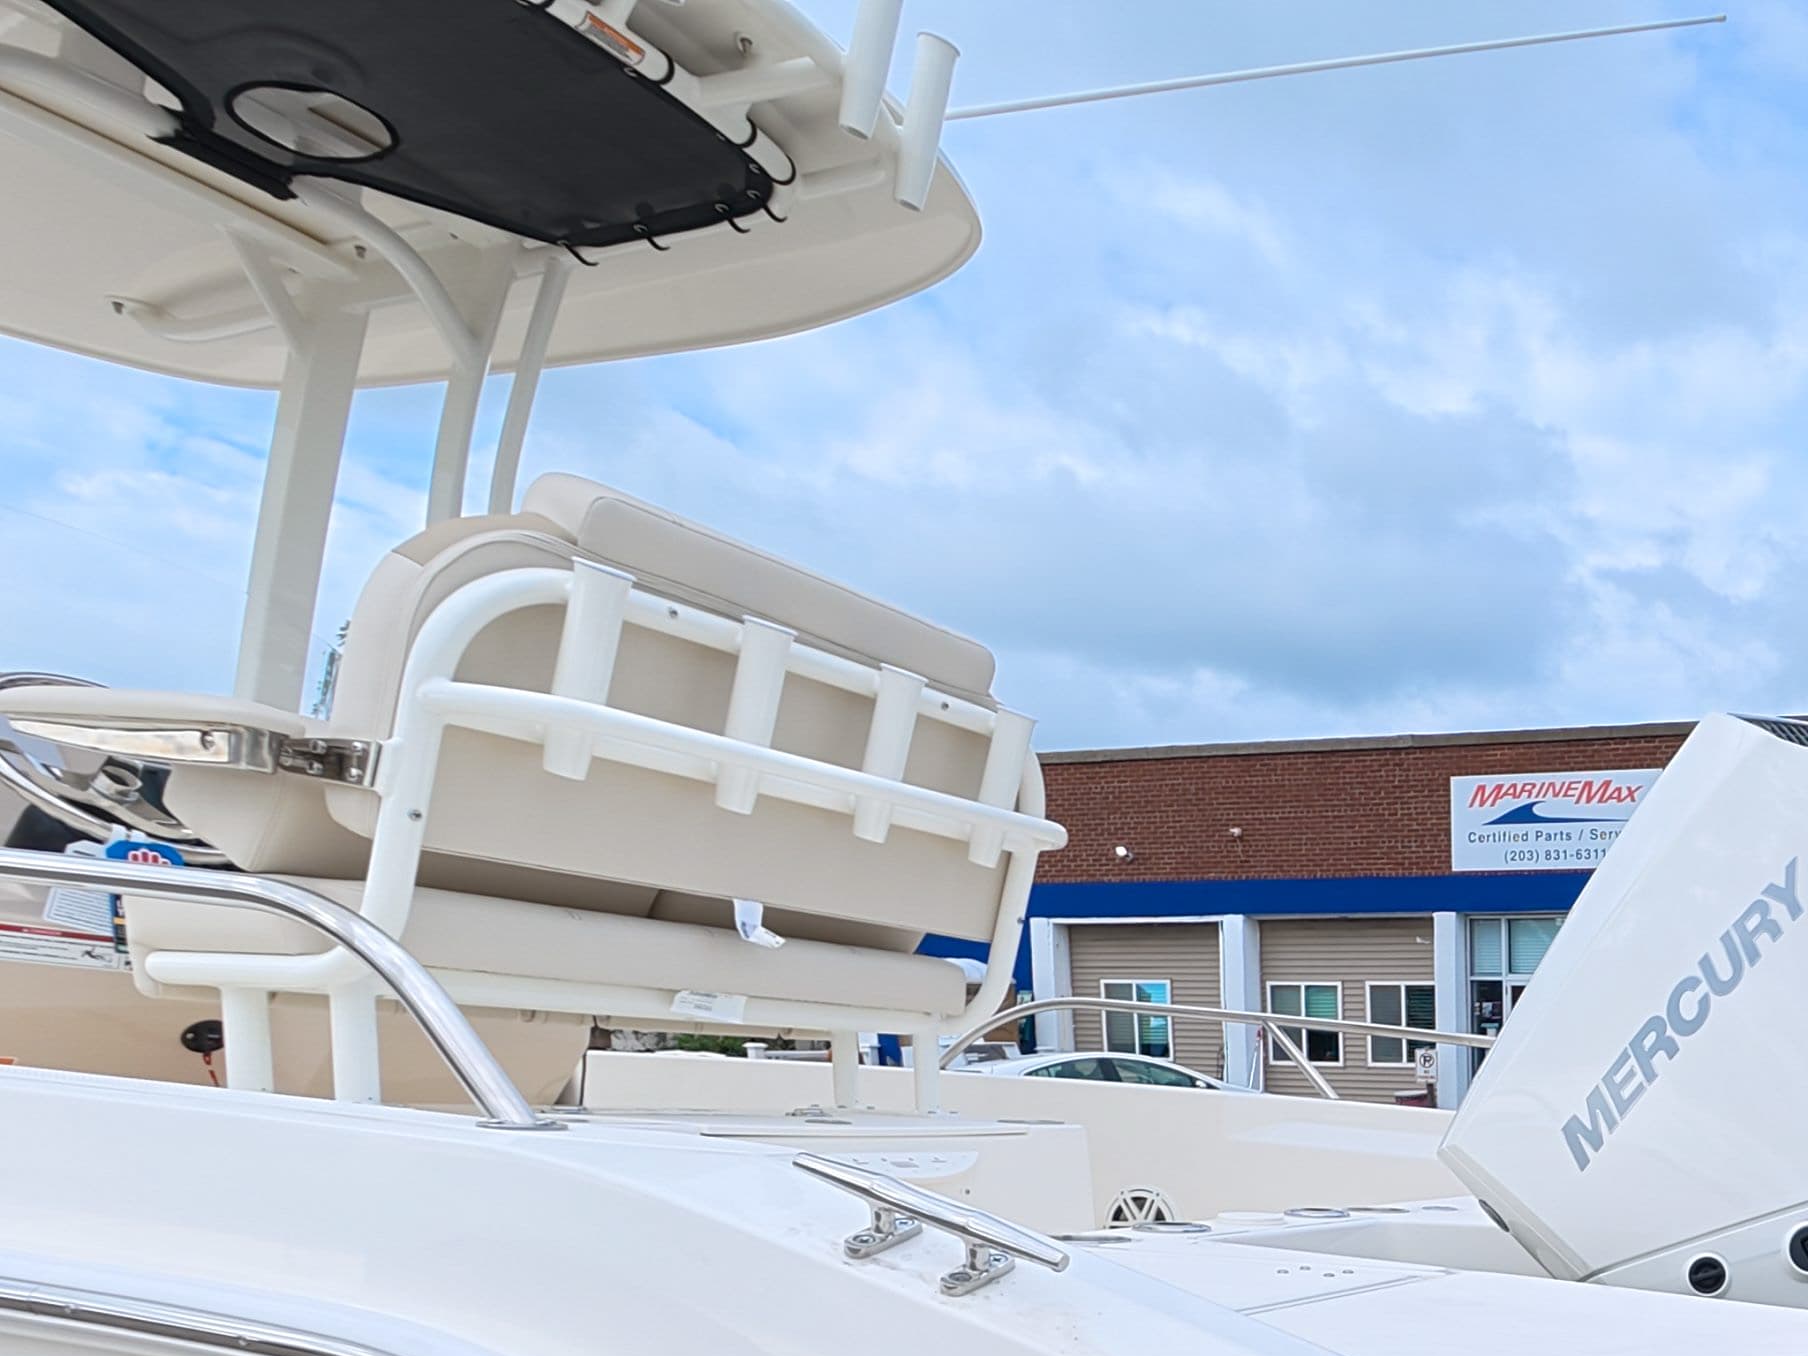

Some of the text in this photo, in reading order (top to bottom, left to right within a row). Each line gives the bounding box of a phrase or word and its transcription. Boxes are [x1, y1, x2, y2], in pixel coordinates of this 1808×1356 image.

[1468, 779, 1643, 809] MARINEMAX
[1468, 831, 1529, 843] Certified
[1535, 830, 1573, 842] Parts
[1578, 829, 1584, 841] /
[1504, 849, 1540, 864] (203)
[1560, 855, 1806, 1174] MERCURY
